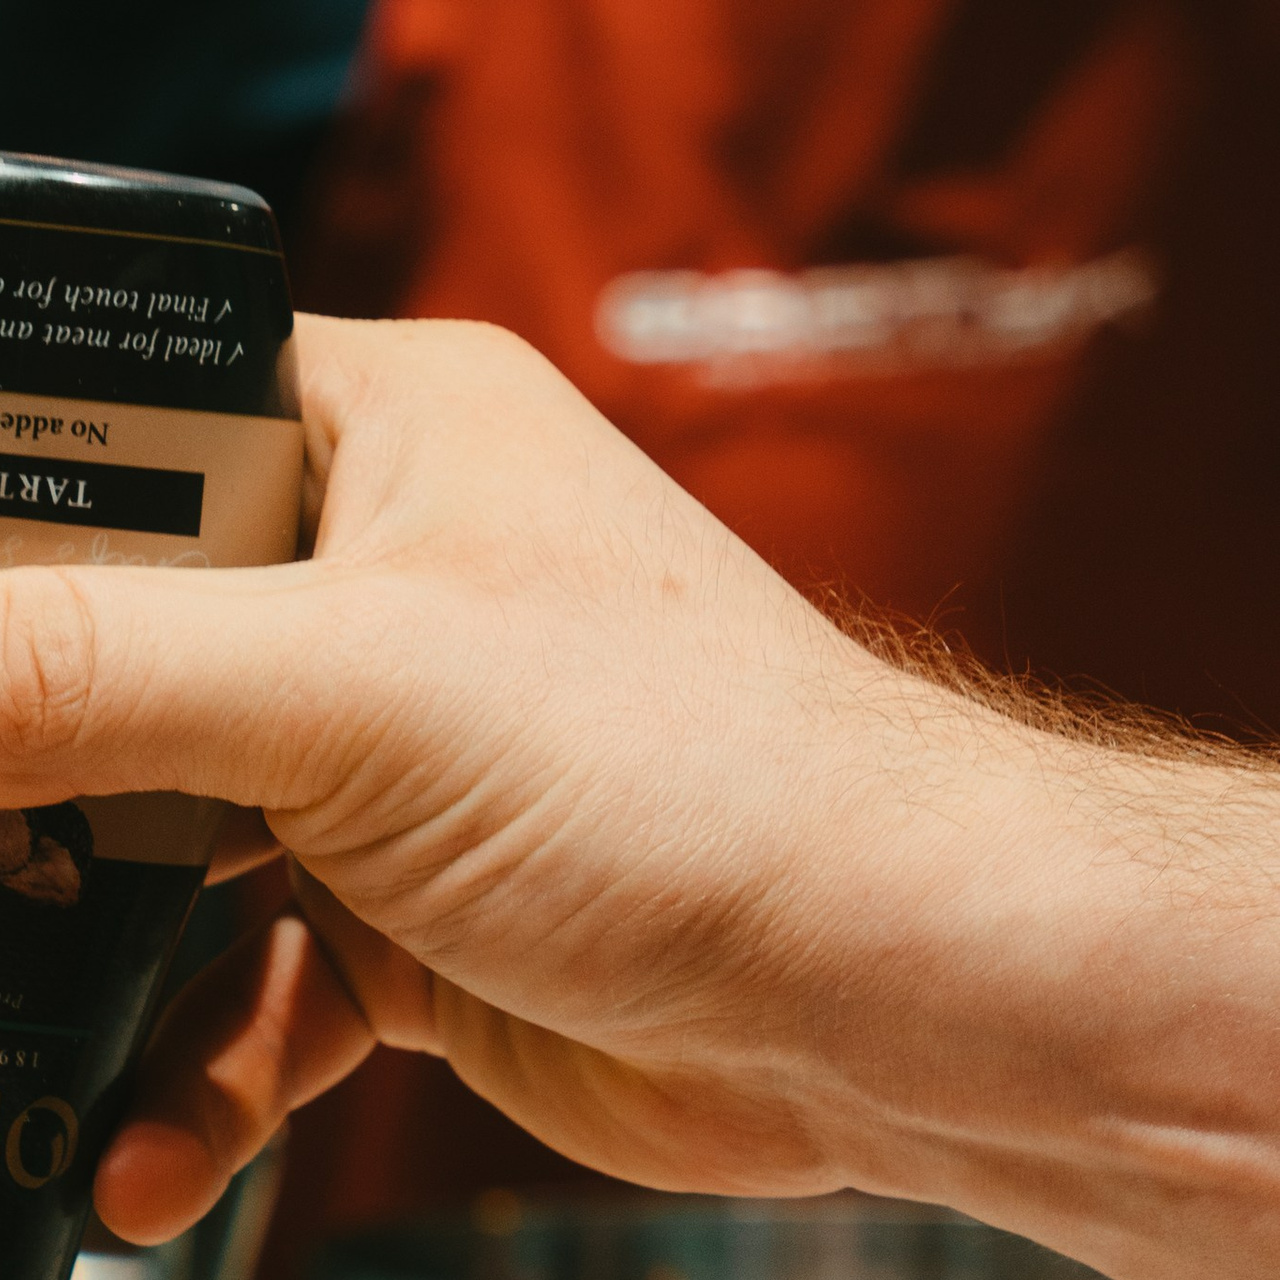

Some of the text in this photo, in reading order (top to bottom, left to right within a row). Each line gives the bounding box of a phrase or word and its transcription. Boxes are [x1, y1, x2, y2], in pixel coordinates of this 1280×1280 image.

[13, 276, 58, 310] for
[64, 283, 139, 314] touch
[147, 291, 210, 323] Final
[41, 322, 111, 347] meat
[118, 327, 161, 361] for
[163, 334, 223, 366] Ideal
[70, 419, 110, 446] No
